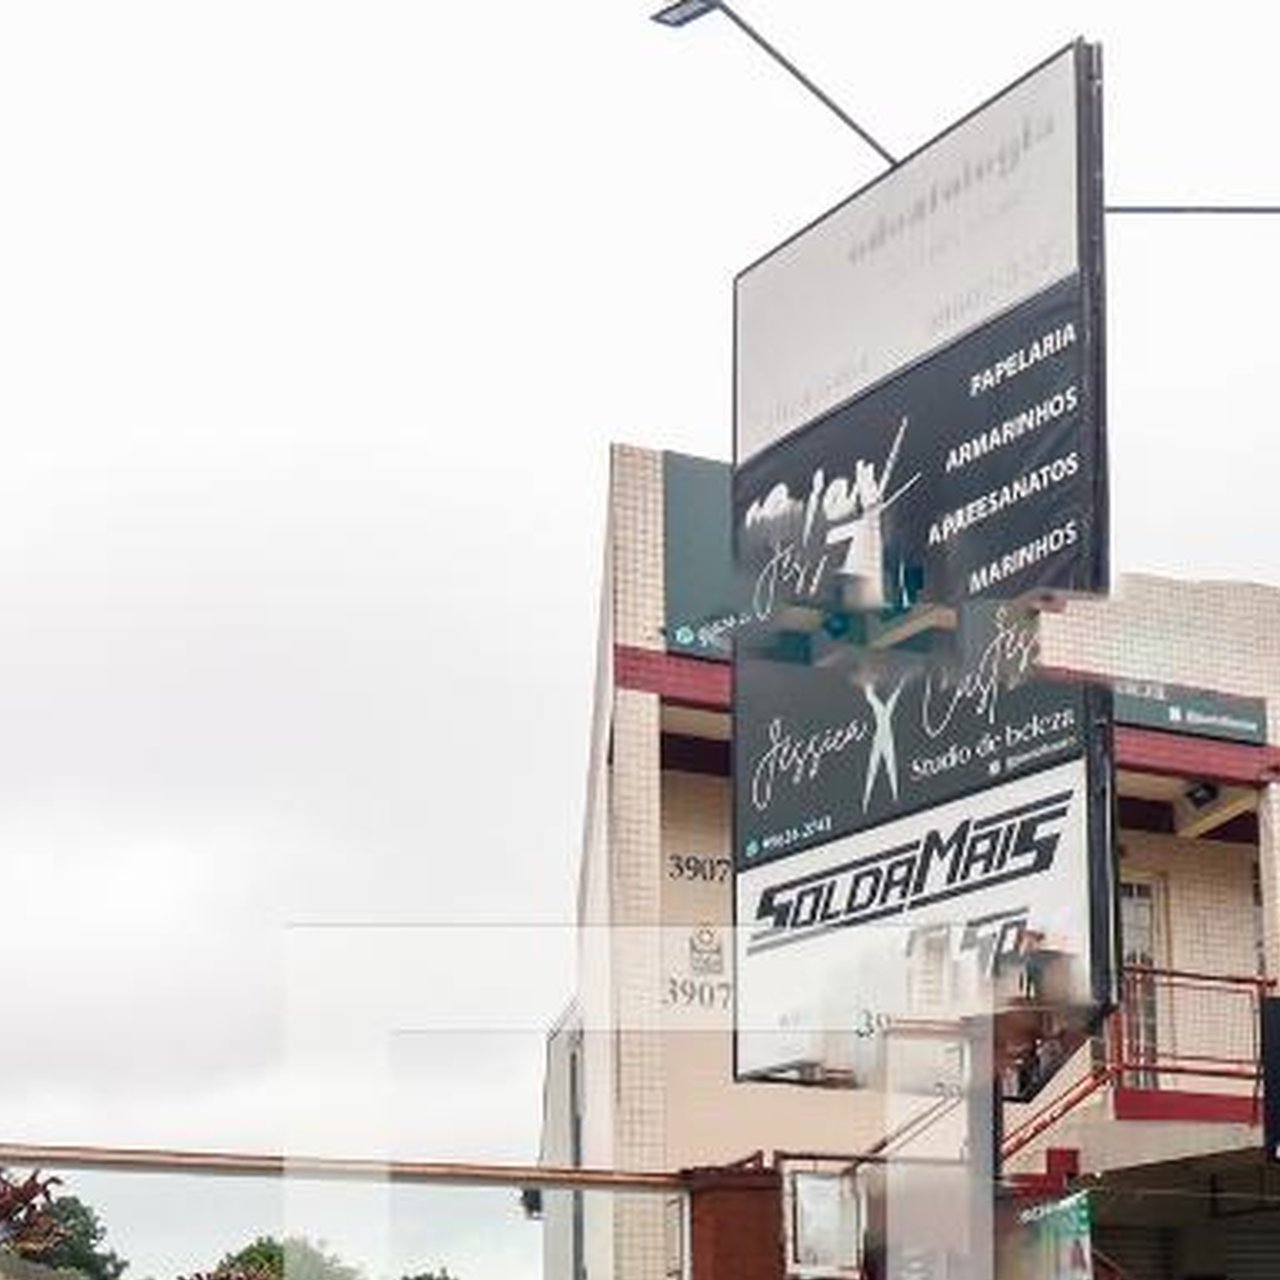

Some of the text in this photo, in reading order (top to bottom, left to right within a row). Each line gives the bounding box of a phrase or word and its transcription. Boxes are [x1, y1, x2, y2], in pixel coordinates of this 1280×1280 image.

[969, 323, 1077, 397] PAPELARIA
[945, 386, 1078, 474] ARMARINHOS
[969, 521, 1077, 594] MARINHOS
[669, 854, 731, 883] 3907
